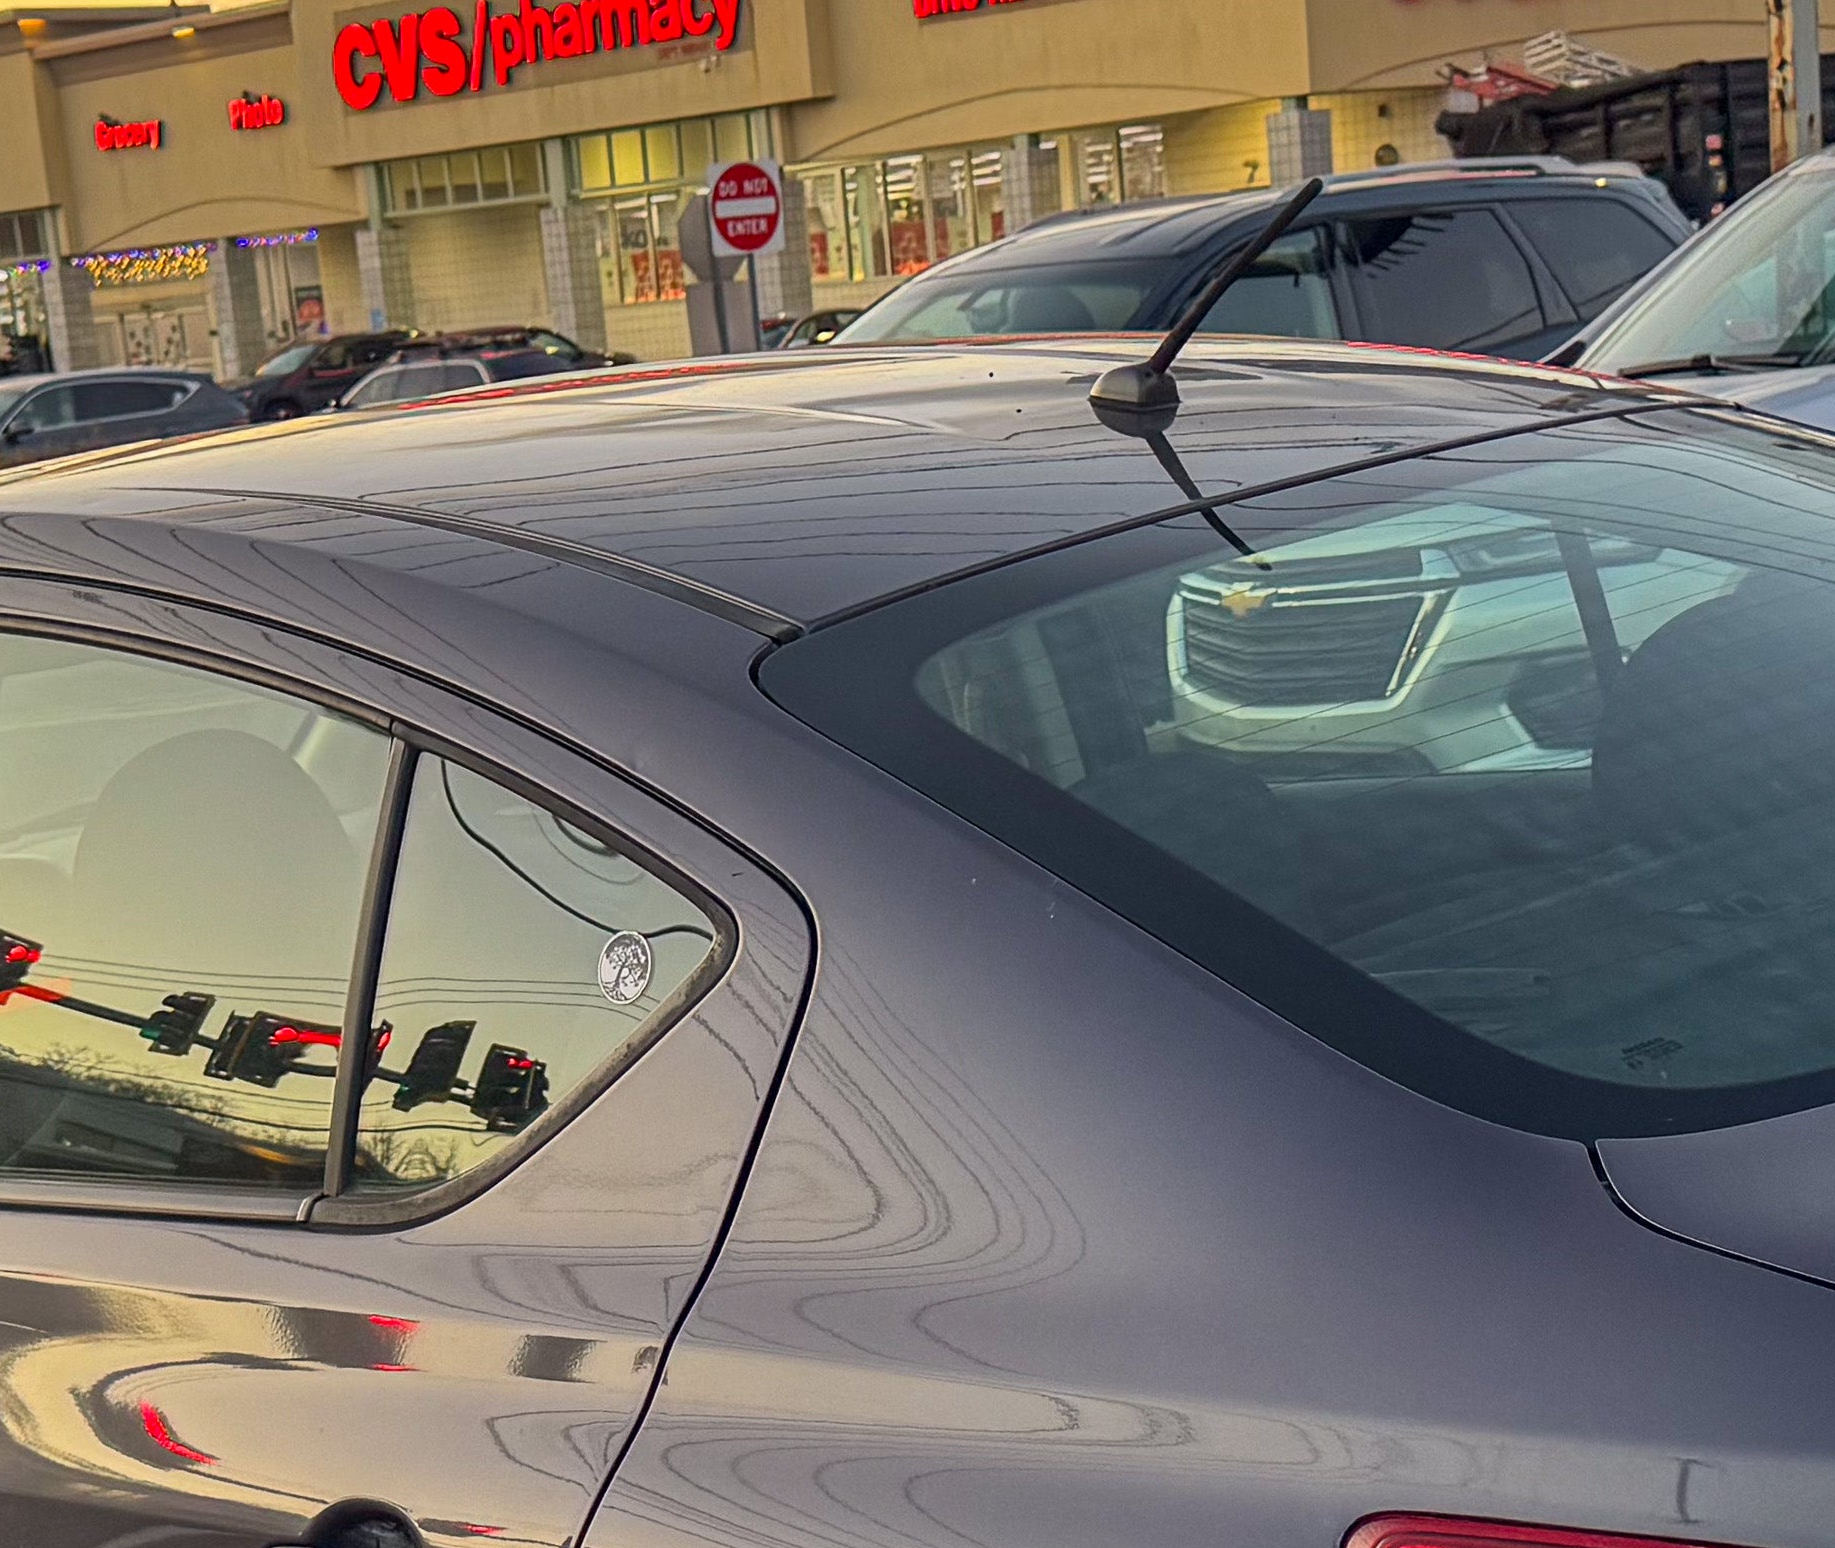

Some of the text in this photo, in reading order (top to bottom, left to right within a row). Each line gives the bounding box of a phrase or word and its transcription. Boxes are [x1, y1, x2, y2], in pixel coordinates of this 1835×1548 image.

[333, 0, 741, 111] CVS/pharmacy
[228, 94, 284, 130] Photo
[95, 119, 161, 152] Grocery
[718, 177, 768, 198] DO NOT
[726, 218, 768, 238] ENTER
